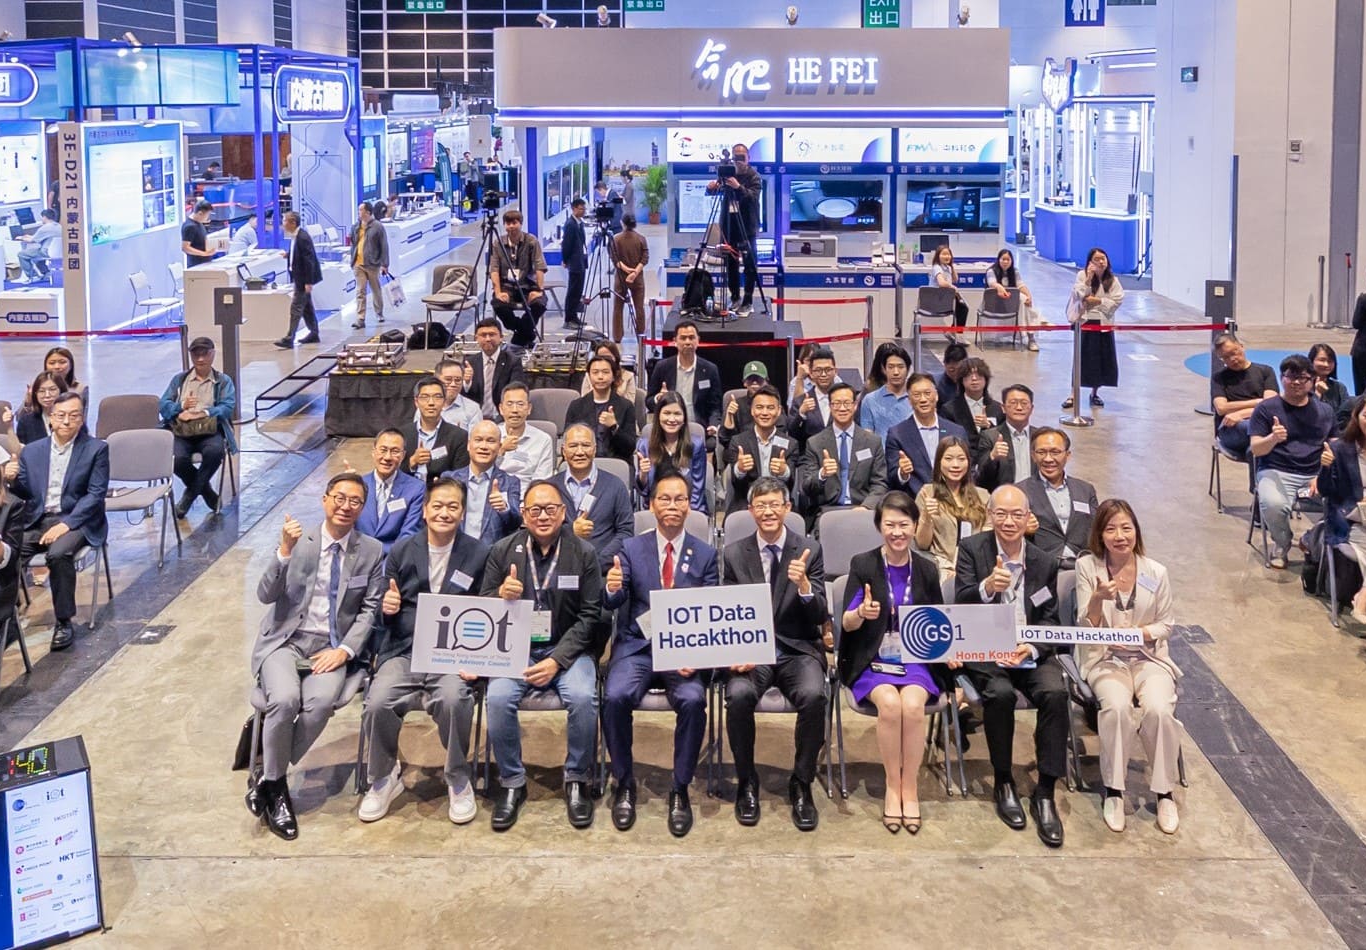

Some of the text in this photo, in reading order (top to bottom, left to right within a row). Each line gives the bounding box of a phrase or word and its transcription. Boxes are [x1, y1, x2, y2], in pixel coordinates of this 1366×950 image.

[869, 10, 899, 24] 出口
[788, 57, 822, 84] HE
[829, 57, 878, 84] FEI
[63, 133, 80, 270] 3E-D21 内蒙古展团
[668, 604, 756, 625] IOT Data
[659, 627, 767, 649] Hacakthon
[1021, 630, 1140, 643] IOT Data Hackathon
[955, 650, 1017, 661] Hong Kong
